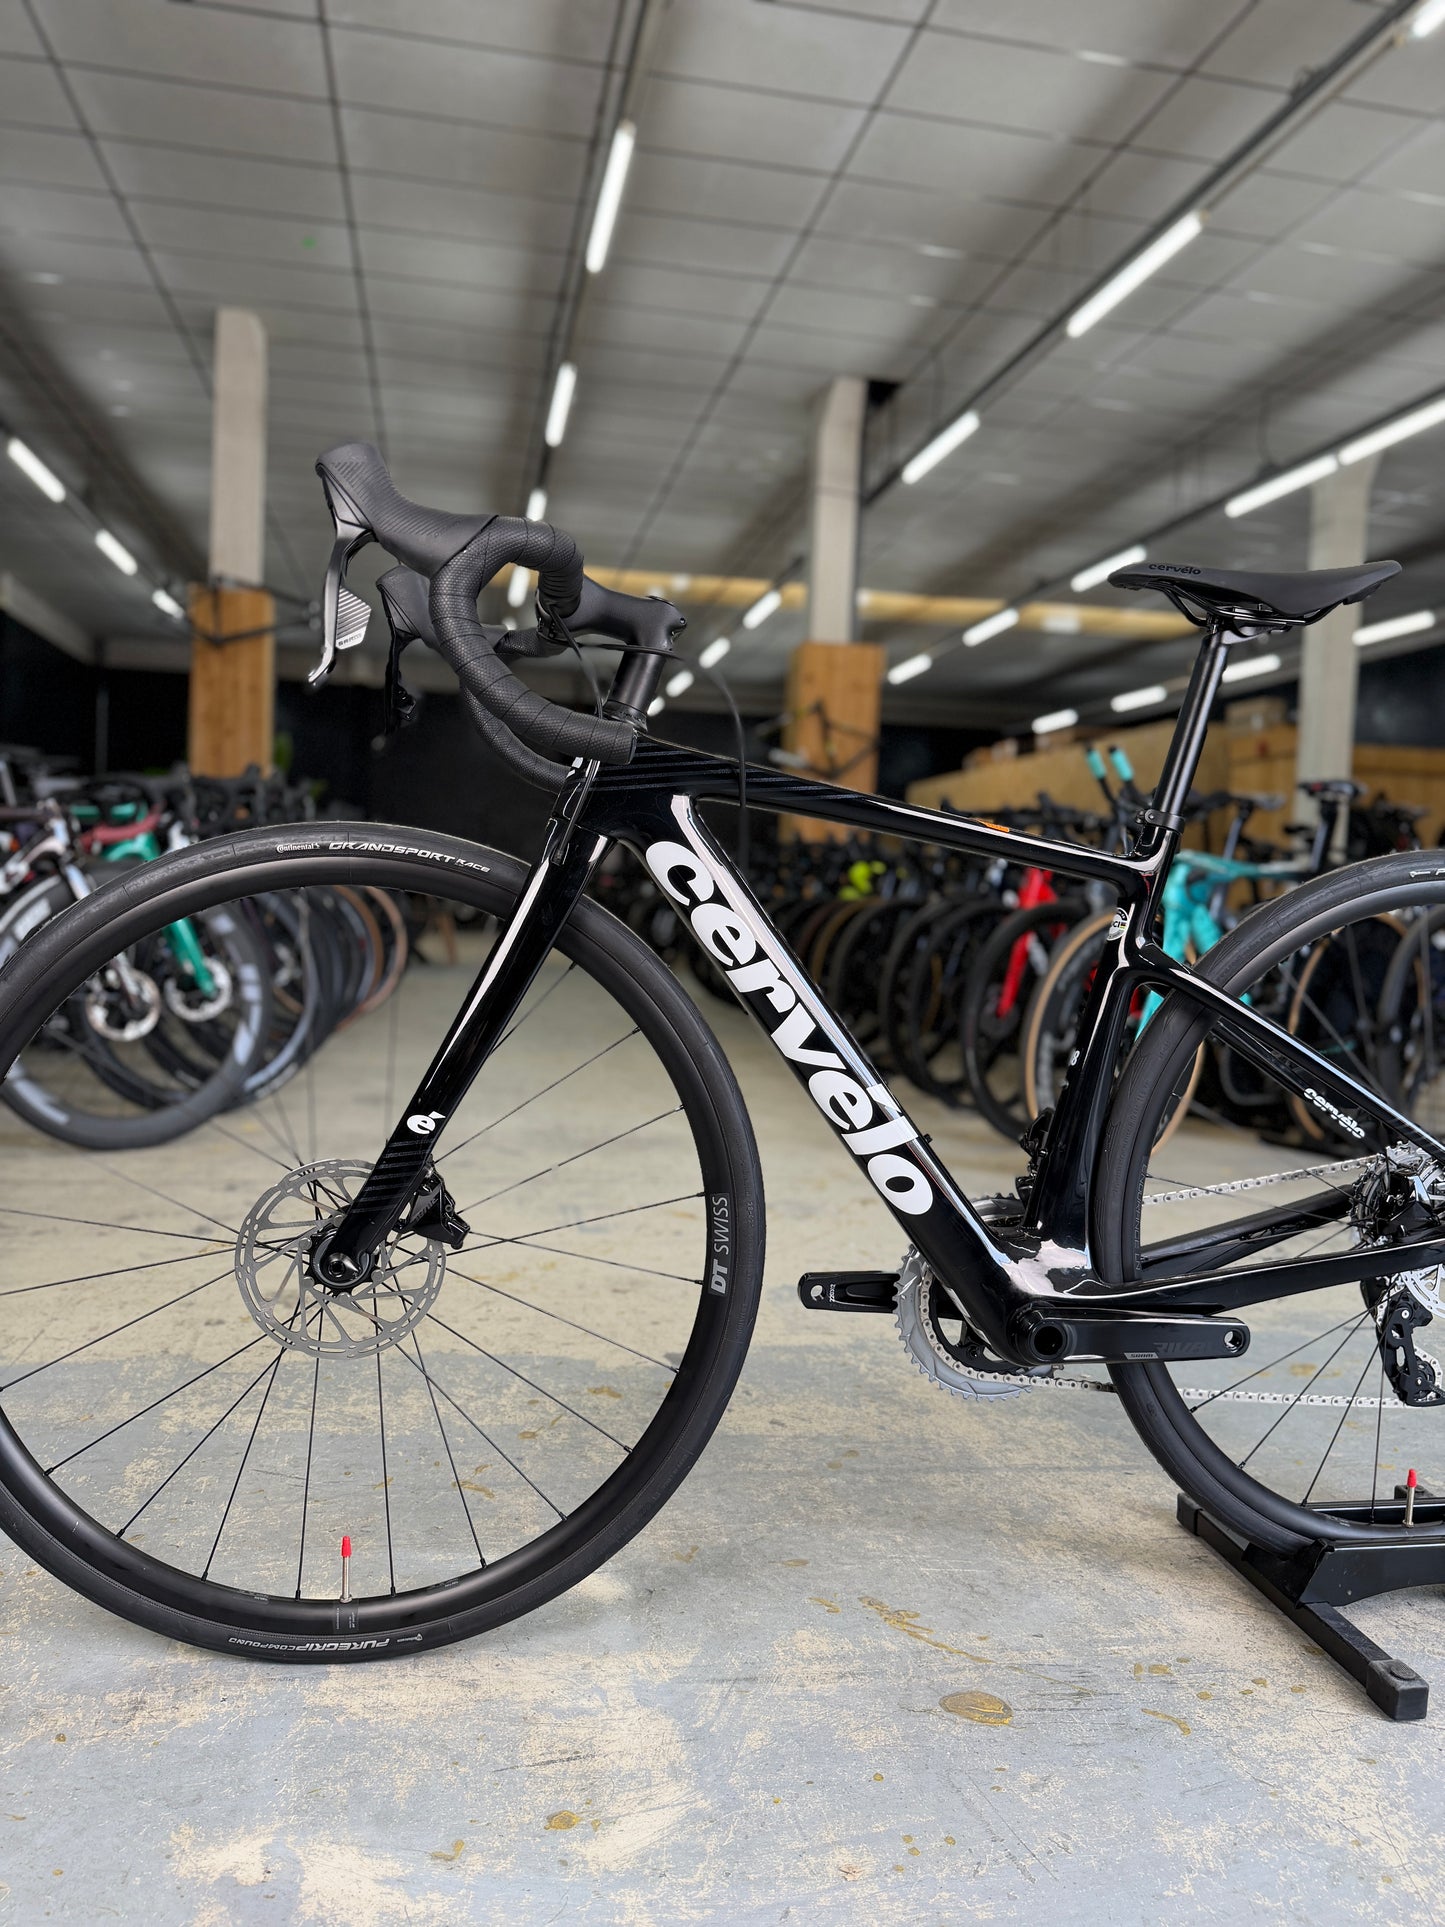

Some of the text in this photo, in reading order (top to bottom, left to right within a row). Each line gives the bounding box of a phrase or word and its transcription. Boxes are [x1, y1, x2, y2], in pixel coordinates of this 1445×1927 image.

[1148, 563, 1201, 575] cervélo
[329, 841, 455, 863] GRANDSPORT
[455, 858, 491, 873] RACE
[646, 841, 933, 1215] cervélo
[1303, 1087, 1365, 1139] cervélo
[711, 1196, 729, 1294] DT SWISS
[228, 1637, 390, 1651] PUREGRIP COMPOUND
